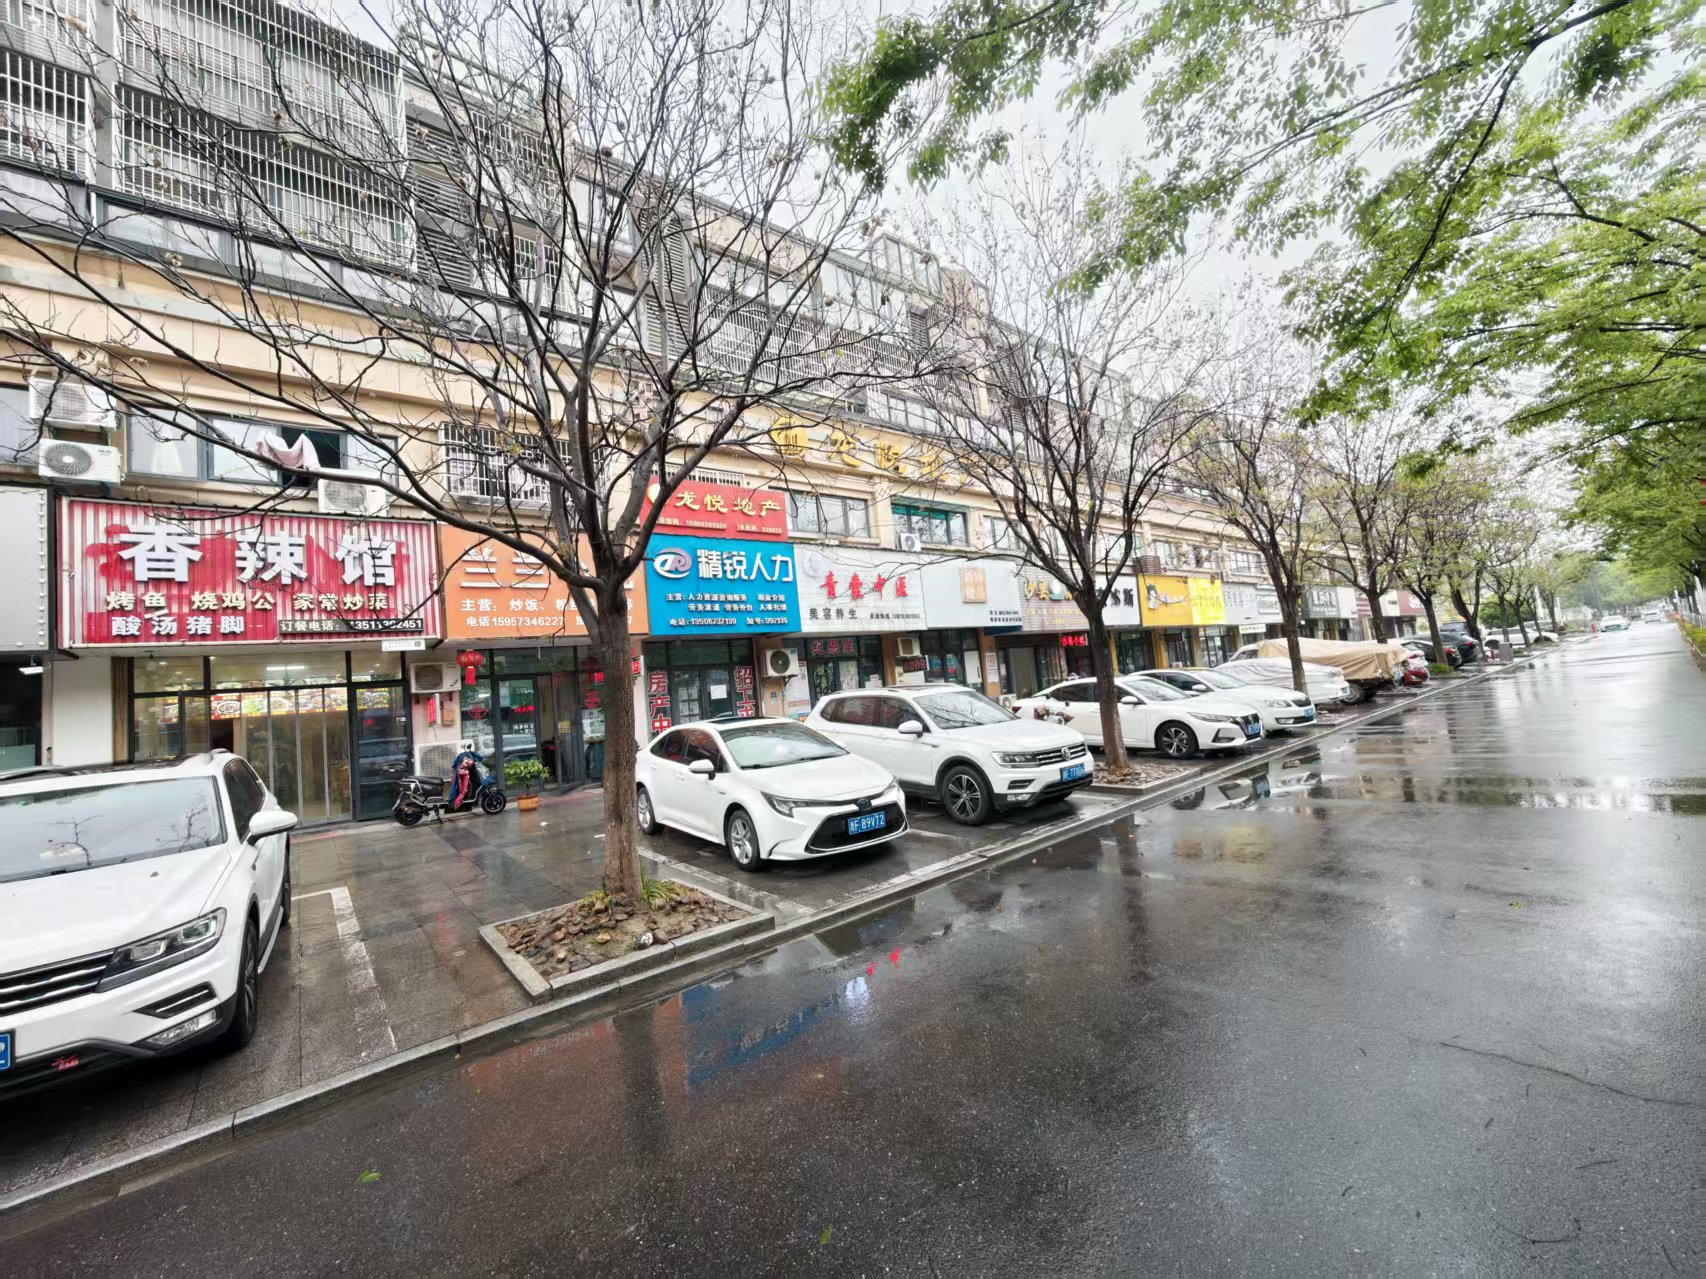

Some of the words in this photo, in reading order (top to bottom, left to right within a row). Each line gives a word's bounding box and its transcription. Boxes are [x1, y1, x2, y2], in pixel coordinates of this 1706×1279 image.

[674, 491, 781, 517] 龙悦地产
[118, 521, 396, 587] 香辣馆
[696, 548, 794, 582] 精锐人力
[106, 591, 168, 617] 烤鱼
[191, 591, 276, 610] 烧鸡公
[293, 592, 388, 611] 家常炒菜
[809, 607, 857, 620] 美容养生
[111, 616, 245, 636] 酸汤猪脚
